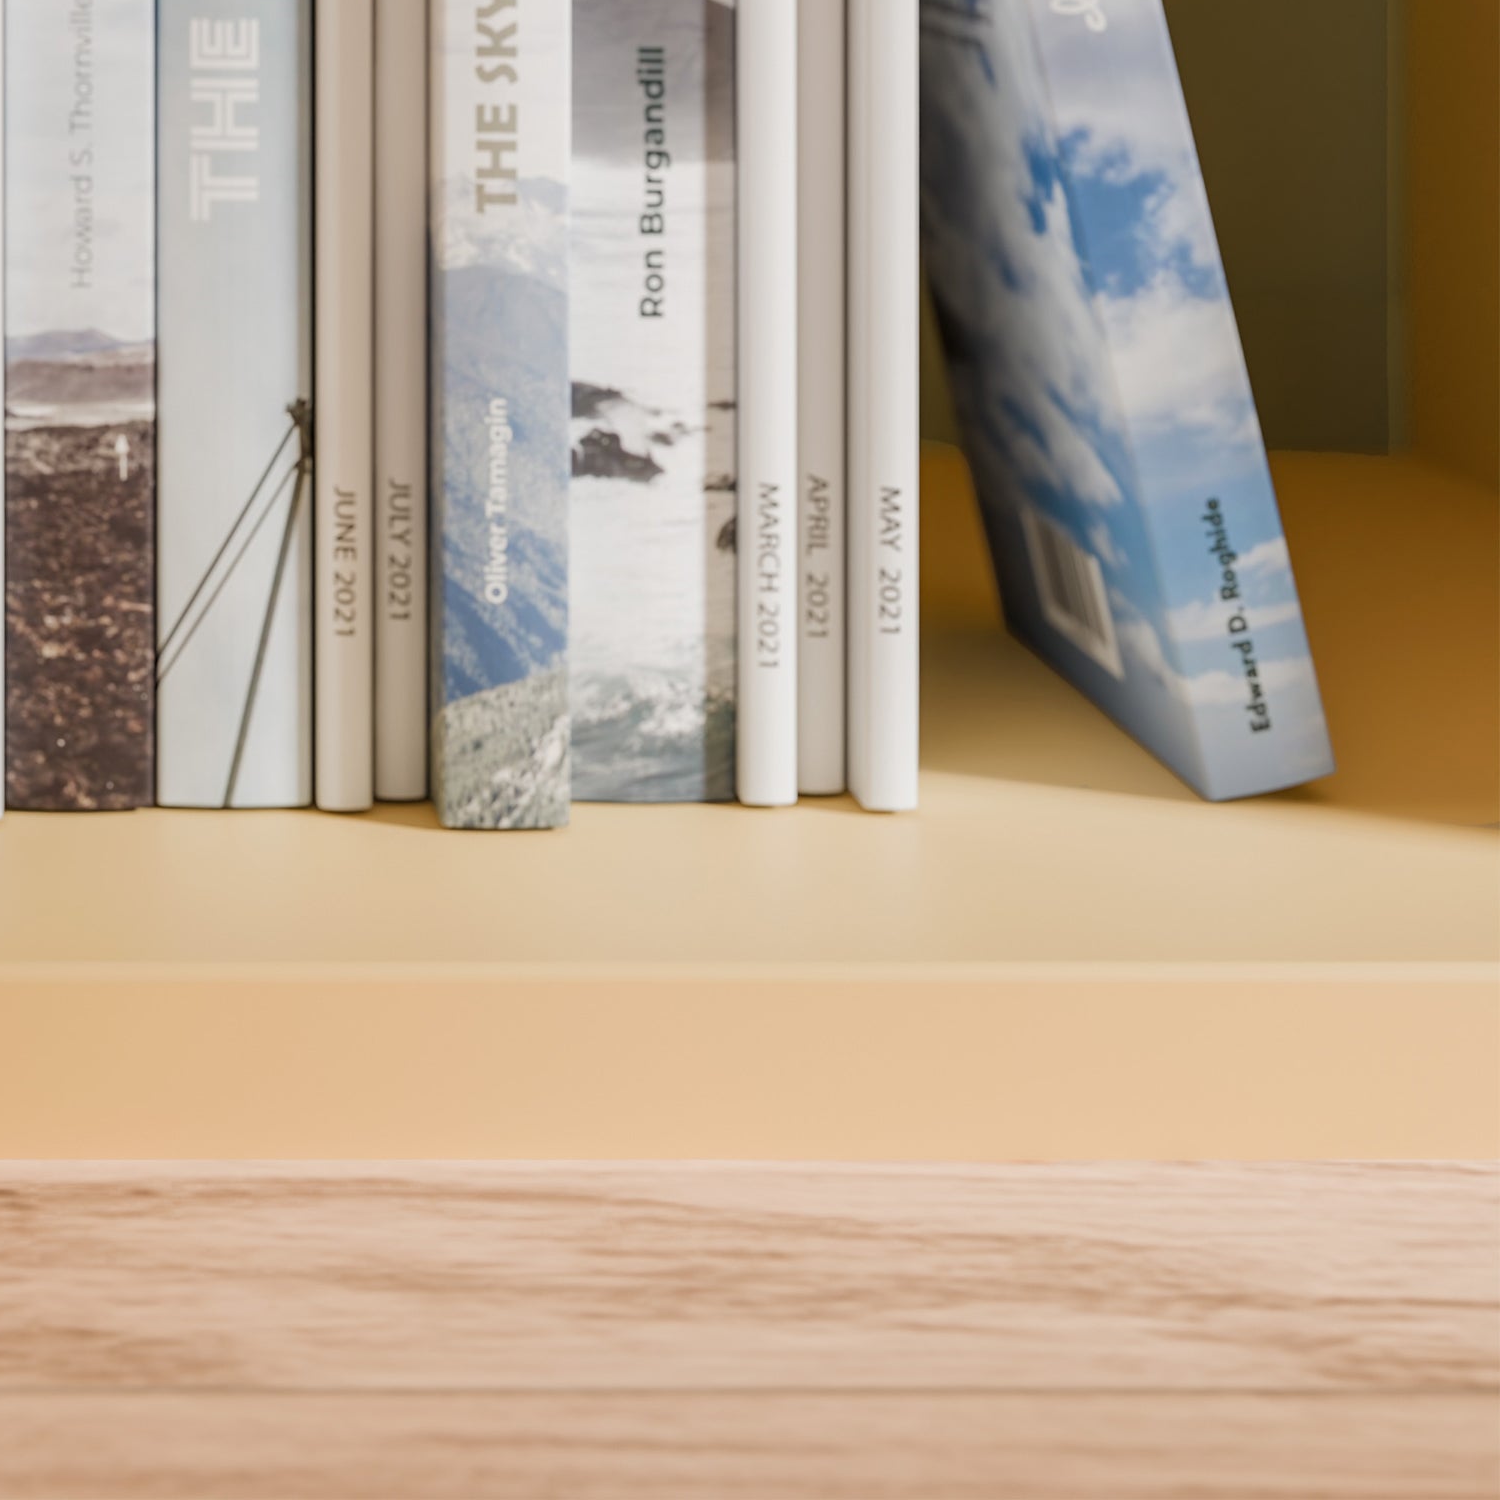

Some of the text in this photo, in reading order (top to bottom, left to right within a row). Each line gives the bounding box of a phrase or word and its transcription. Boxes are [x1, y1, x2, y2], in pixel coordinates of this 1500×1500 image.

[69, 139, 93, 169] S.
[189, 18, 260, 221] THE
[475, 104, 518, 214] THE
[636, 46, 672, 319] Ron Burgandill
[69, 175, 93, 290] Howard
[333, 485, 357, 638] JUNE 2021
[388, 478, 412, 621] JULY 2021
[484, 397, 513, 605] Oliver Tamagin
[757, 482, 780, 669] MARCH 2021
[806, 473, 830, 639] APRIL 2021
[879, 485, 902, 635] MAY 2021
[1201, 497, 1271, 734] Edward D. Roghide
